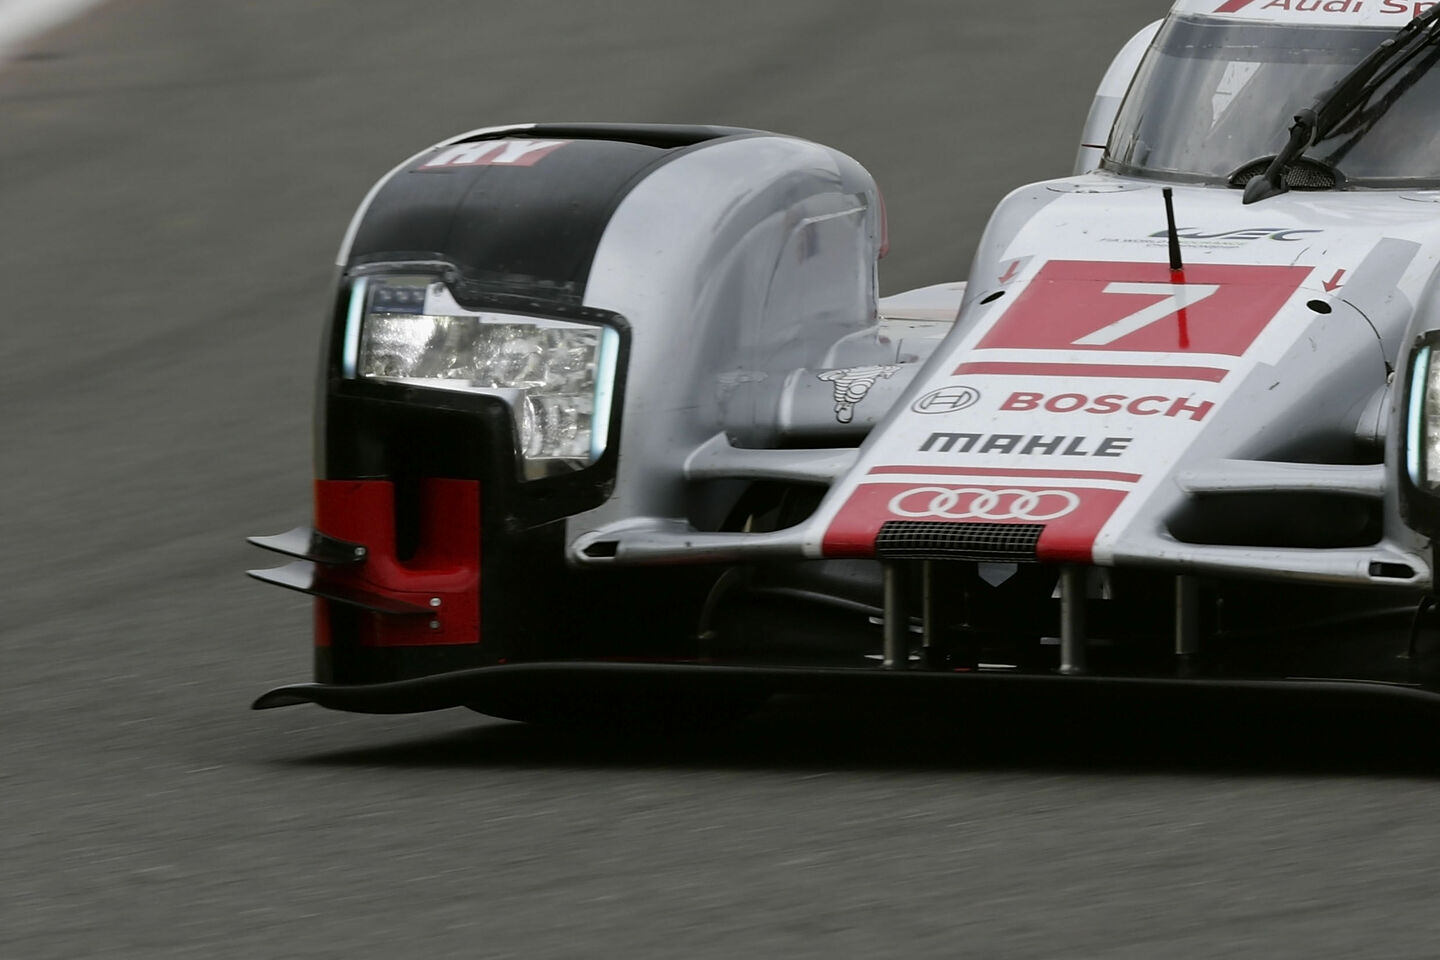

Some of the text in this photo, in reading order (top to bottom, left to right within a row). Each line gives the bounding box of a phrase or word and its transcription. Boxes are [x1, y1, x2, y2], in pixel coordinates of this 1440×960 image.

[424, 140, 567, 167] HY
[1071, 282, 1221, 346] 7
[998, 391, 1216, 422] BOSCH
[918, 432, 1134, 458] MAHLE
